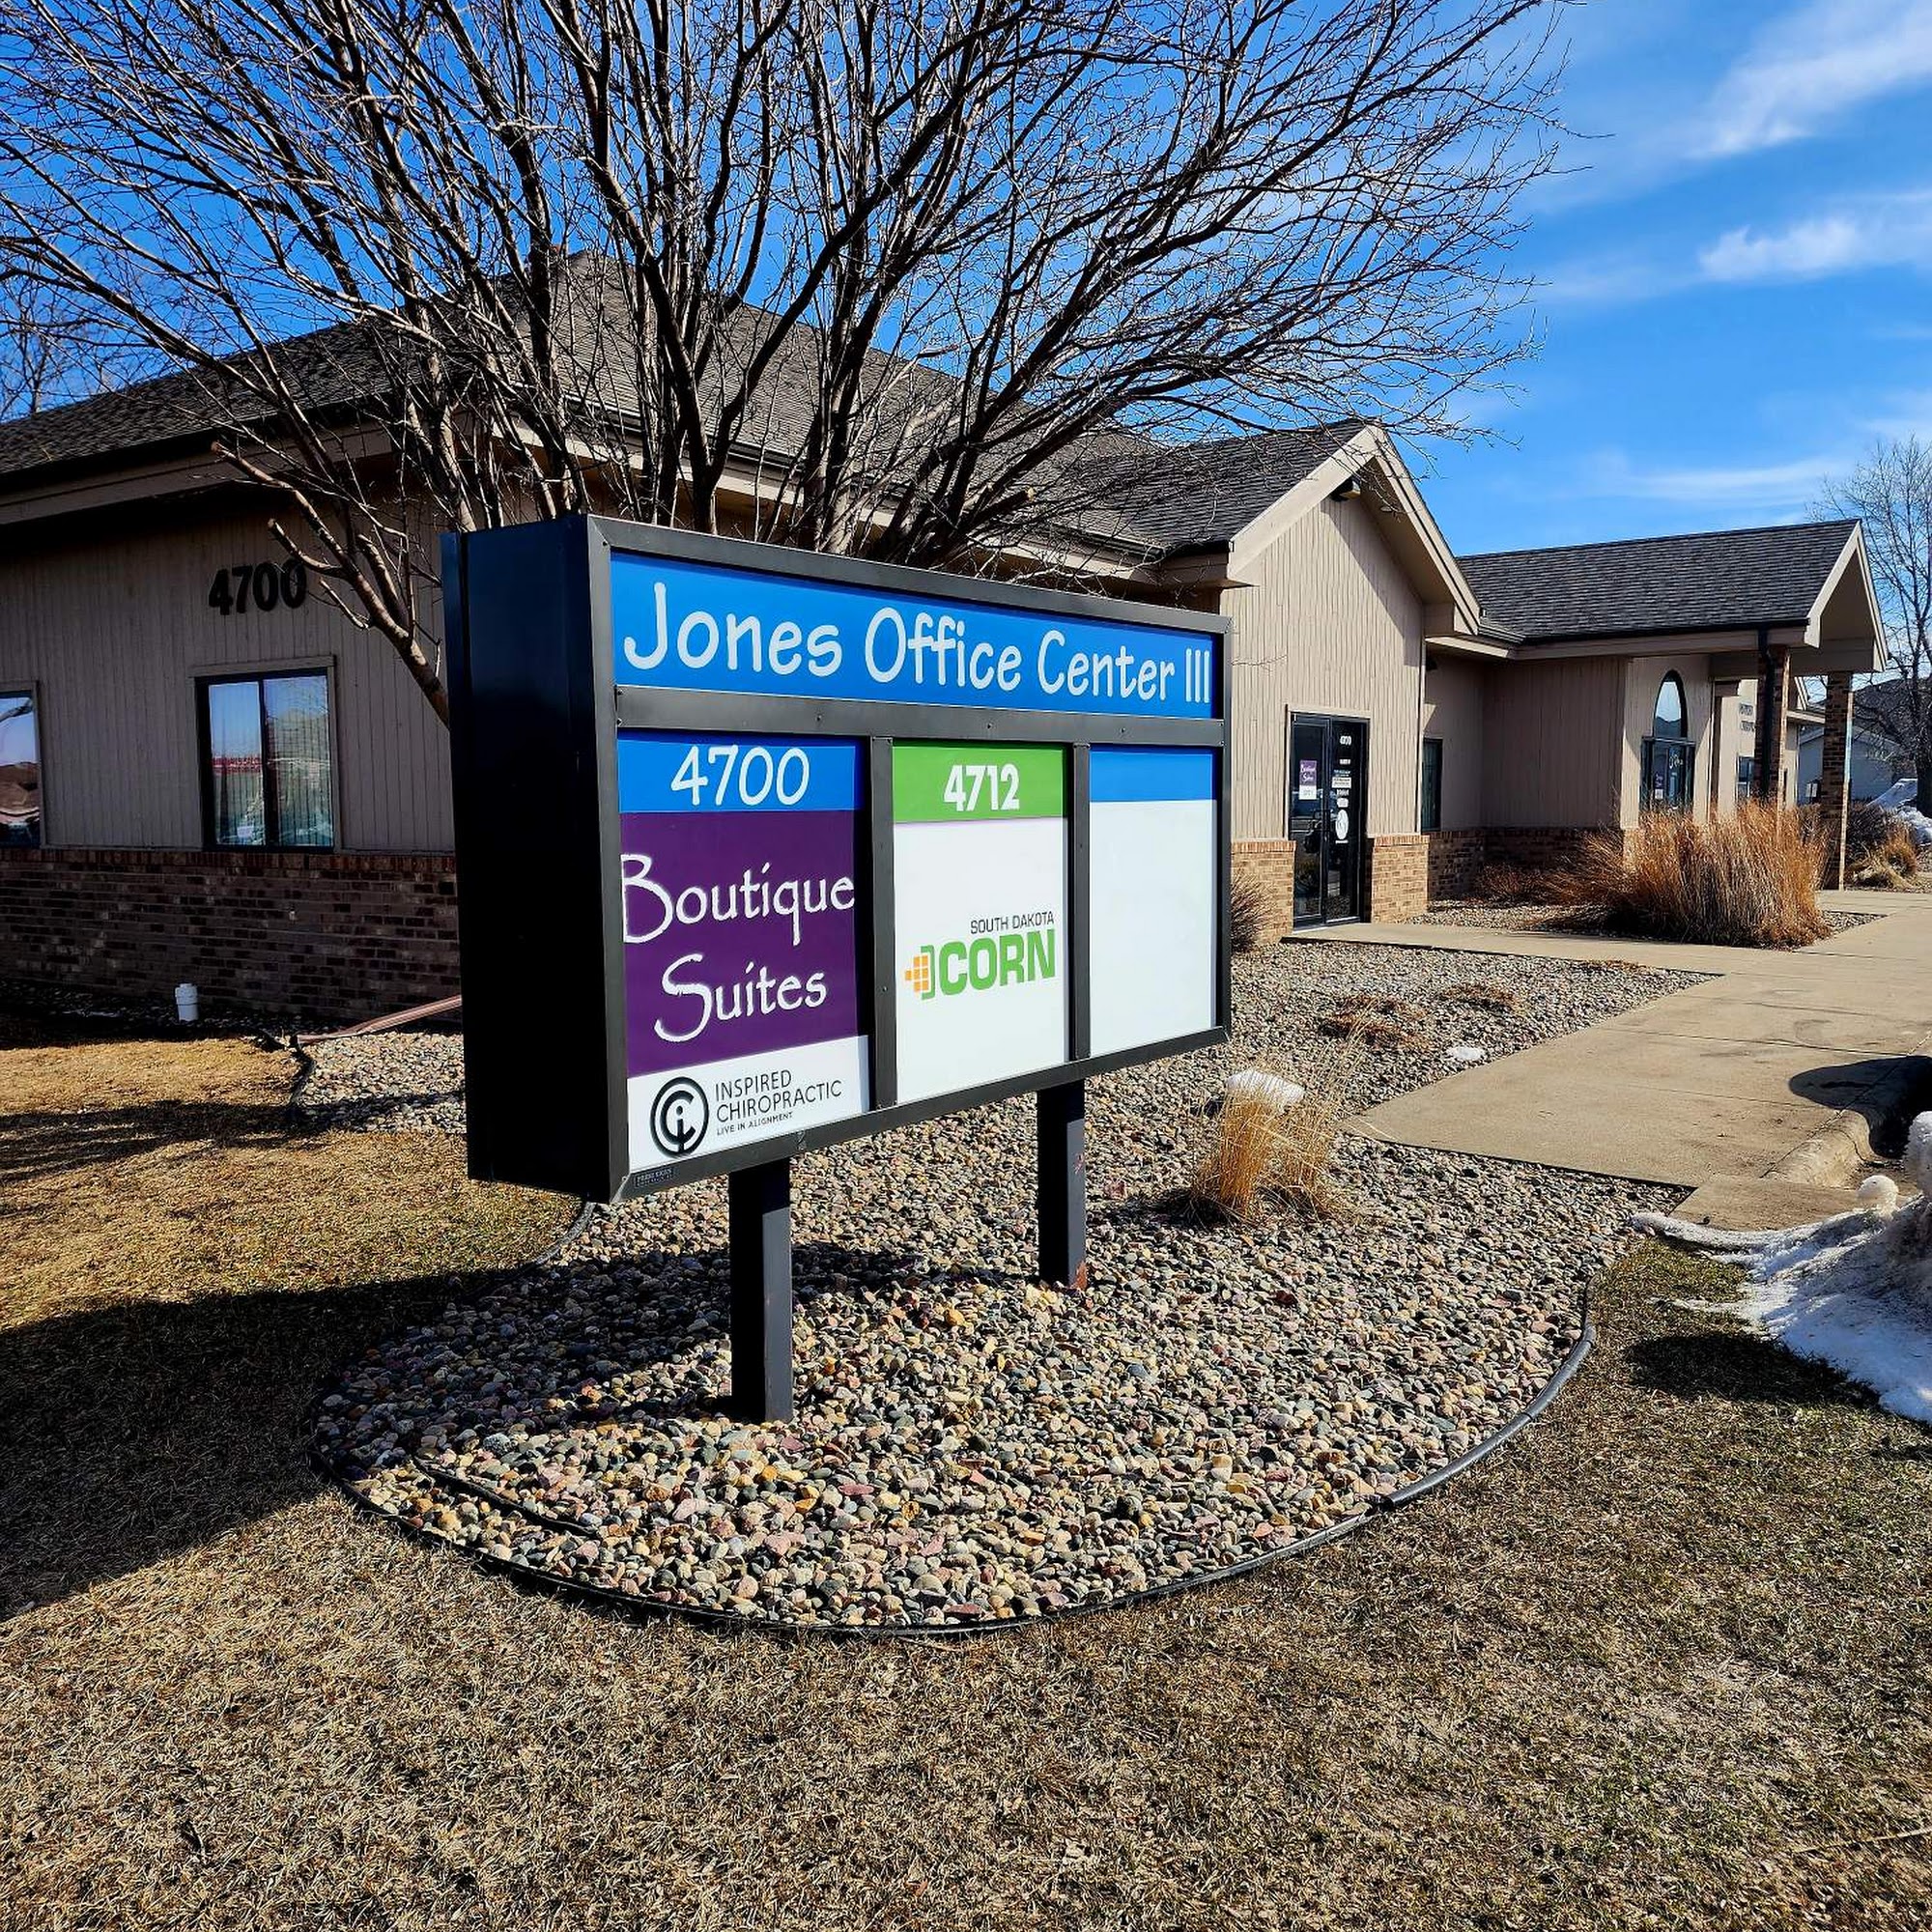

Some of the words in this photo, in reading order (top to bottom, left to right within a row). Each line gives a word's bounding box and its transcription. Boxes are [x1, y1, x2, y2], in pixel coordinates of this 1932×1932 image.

[209, 557, 306, 615] 4700
[624, 582, 842, 677] Jones
[866, 607, 1022, 691] Office
[1037, 631, 1176, 700] Center
[670, 744, 810, 806] 4700
[943, 763, 1020, 811] 4712
[621, 854, 855, 947] Boutique
[970, 916, 1009, 935] SOUTH
[1011, 910, 1055, 930] DAKOTA
[938, 928, 1056, 996] CORN
[654, 952, 827, 1042] Suites
[715, 1069, 792, 1102] INSPIRED
[716, 1080, 842, 1122] CHIROPRACTIC
[717, 1125, 735, 1136] LIVE
[737, 1122, 747, 1131] IN
[748, 1111, 794, 1129] ALIGNMENT
